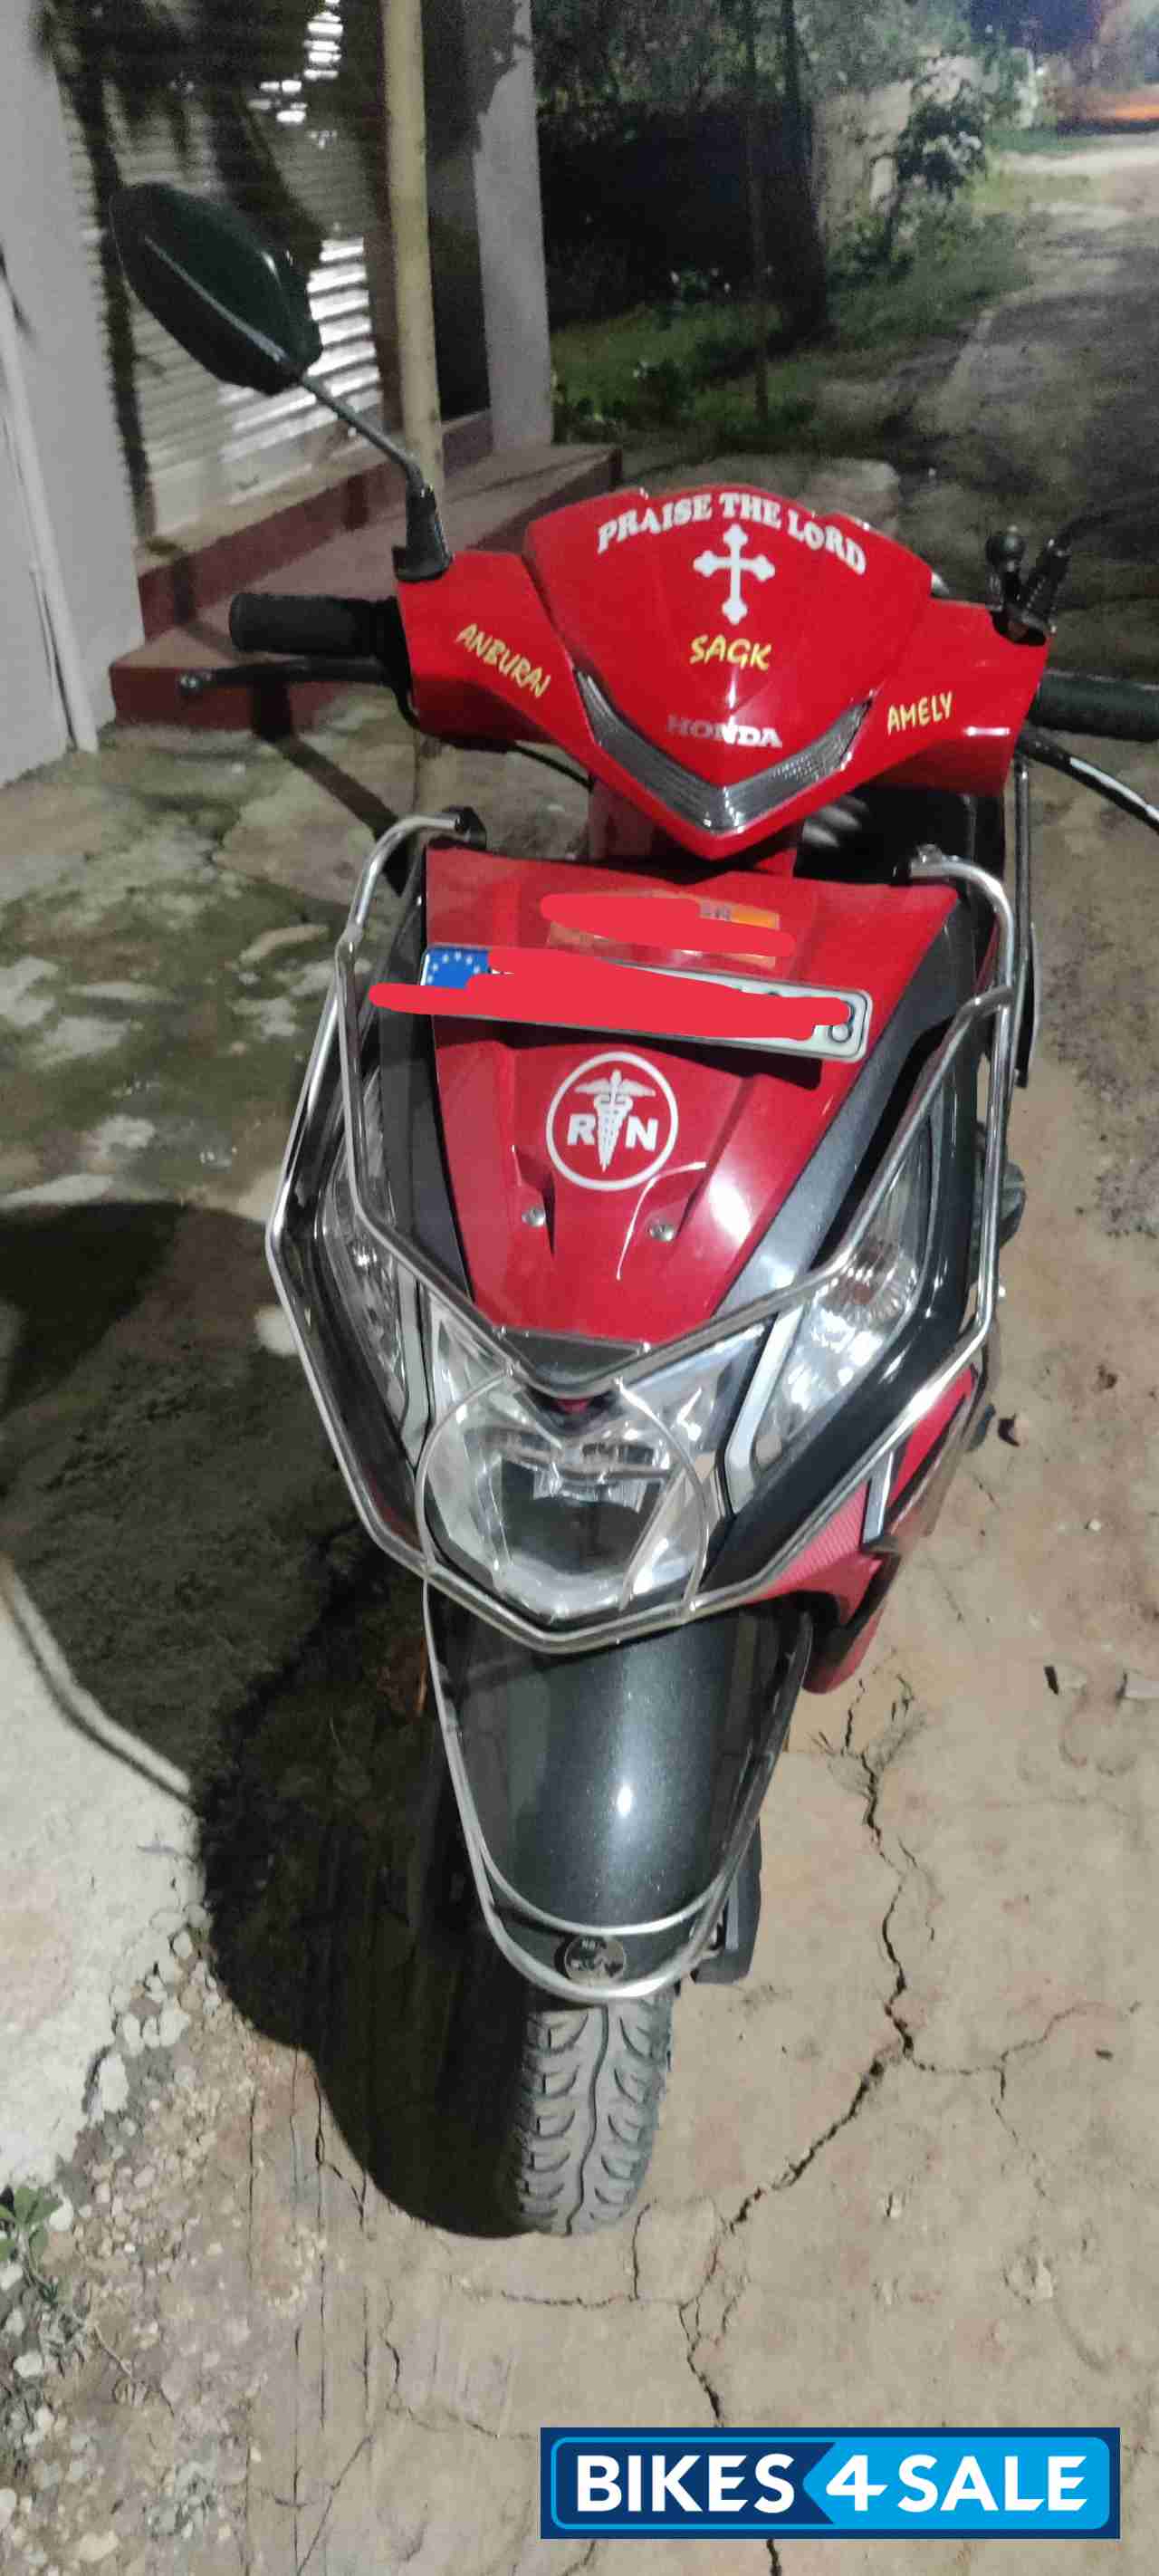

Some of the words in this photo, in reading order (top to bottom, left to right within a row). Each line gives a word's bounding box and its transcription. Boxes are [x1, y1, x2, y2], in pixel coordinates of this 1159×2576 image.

[597, 494, 713, 554] PRAISE
[719, 492, 781, 529] THE
[787, 508, 867, 575] LORD
[455, 622, 551, 698] ANBURAJ
[689, 634, 772, 671] SAGK
[666, 714, 782, 748] HONDA
[887, 690, 953, 736] AMELY
